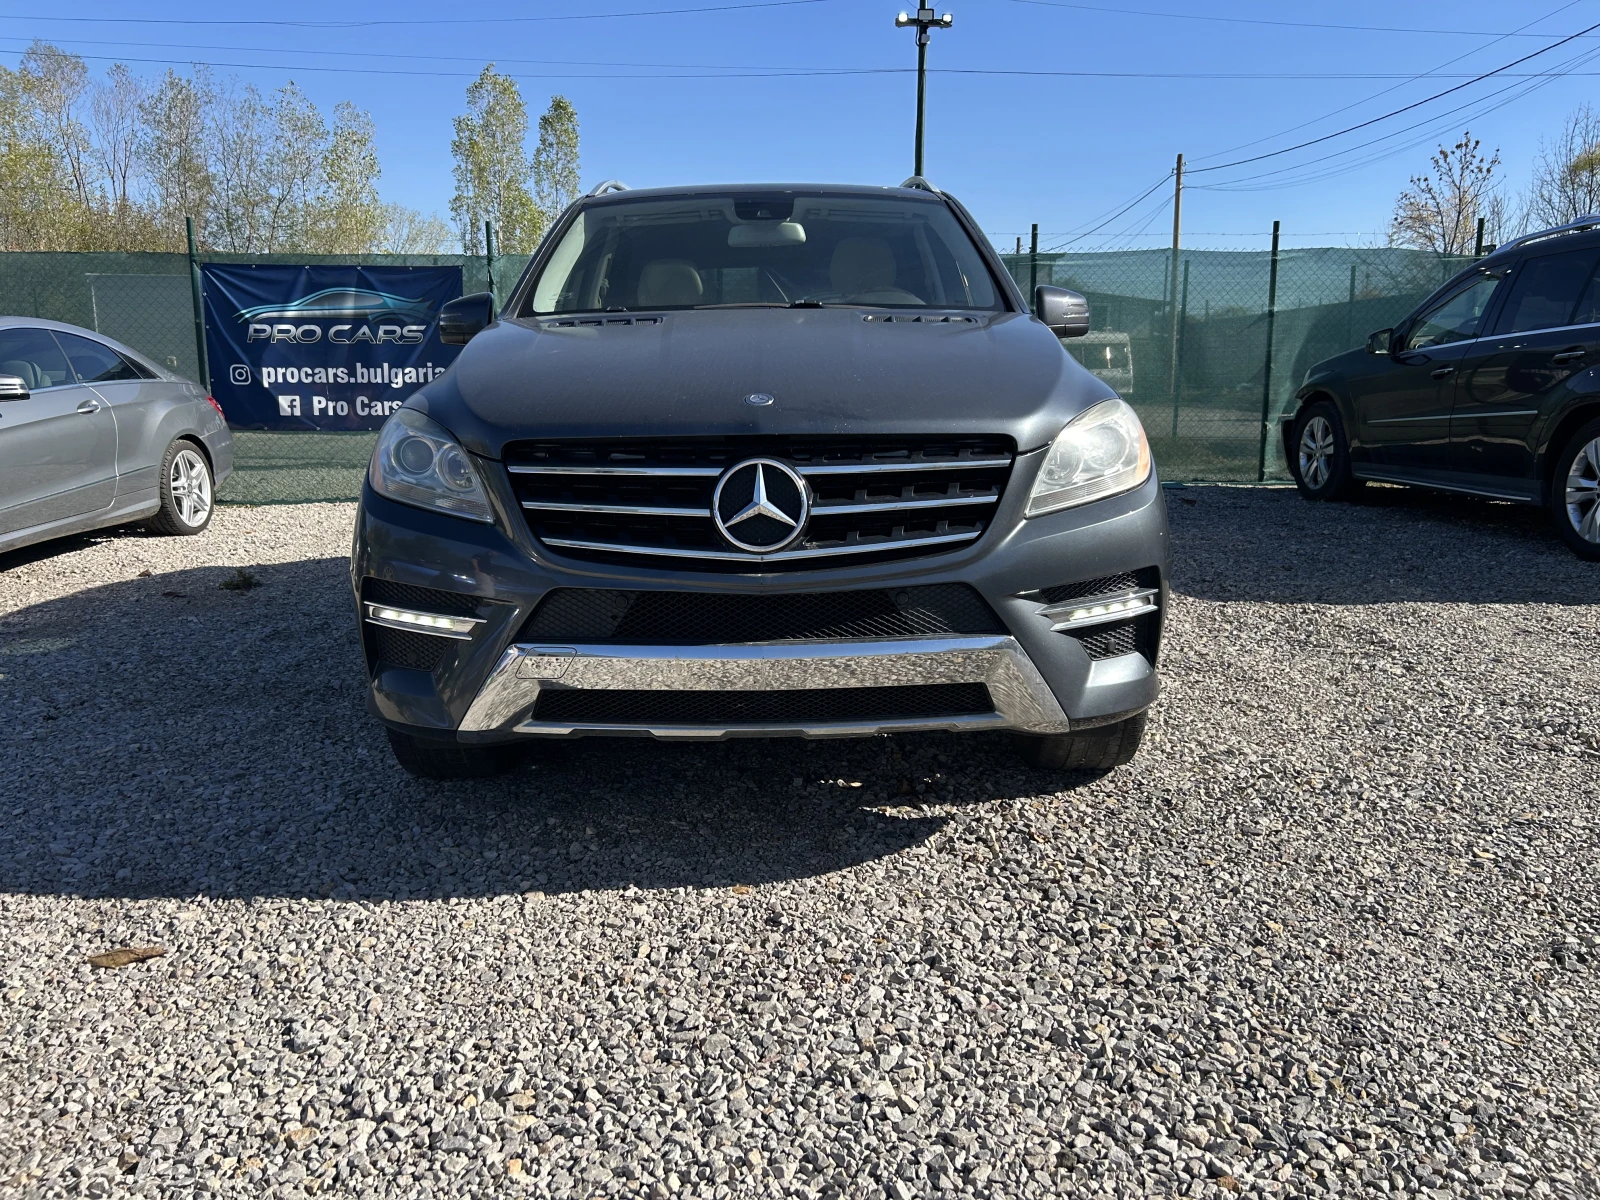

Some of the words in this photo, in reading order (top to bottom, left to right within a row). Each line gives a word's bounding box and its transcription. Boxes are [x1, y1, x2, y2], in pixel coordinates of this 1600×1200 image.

[247, 324, 321, 343] PRO
[328, 325, 426, 344] CARS
[313, 396, 348, 416] Pro
[356, 395, 403, 416] Cars
